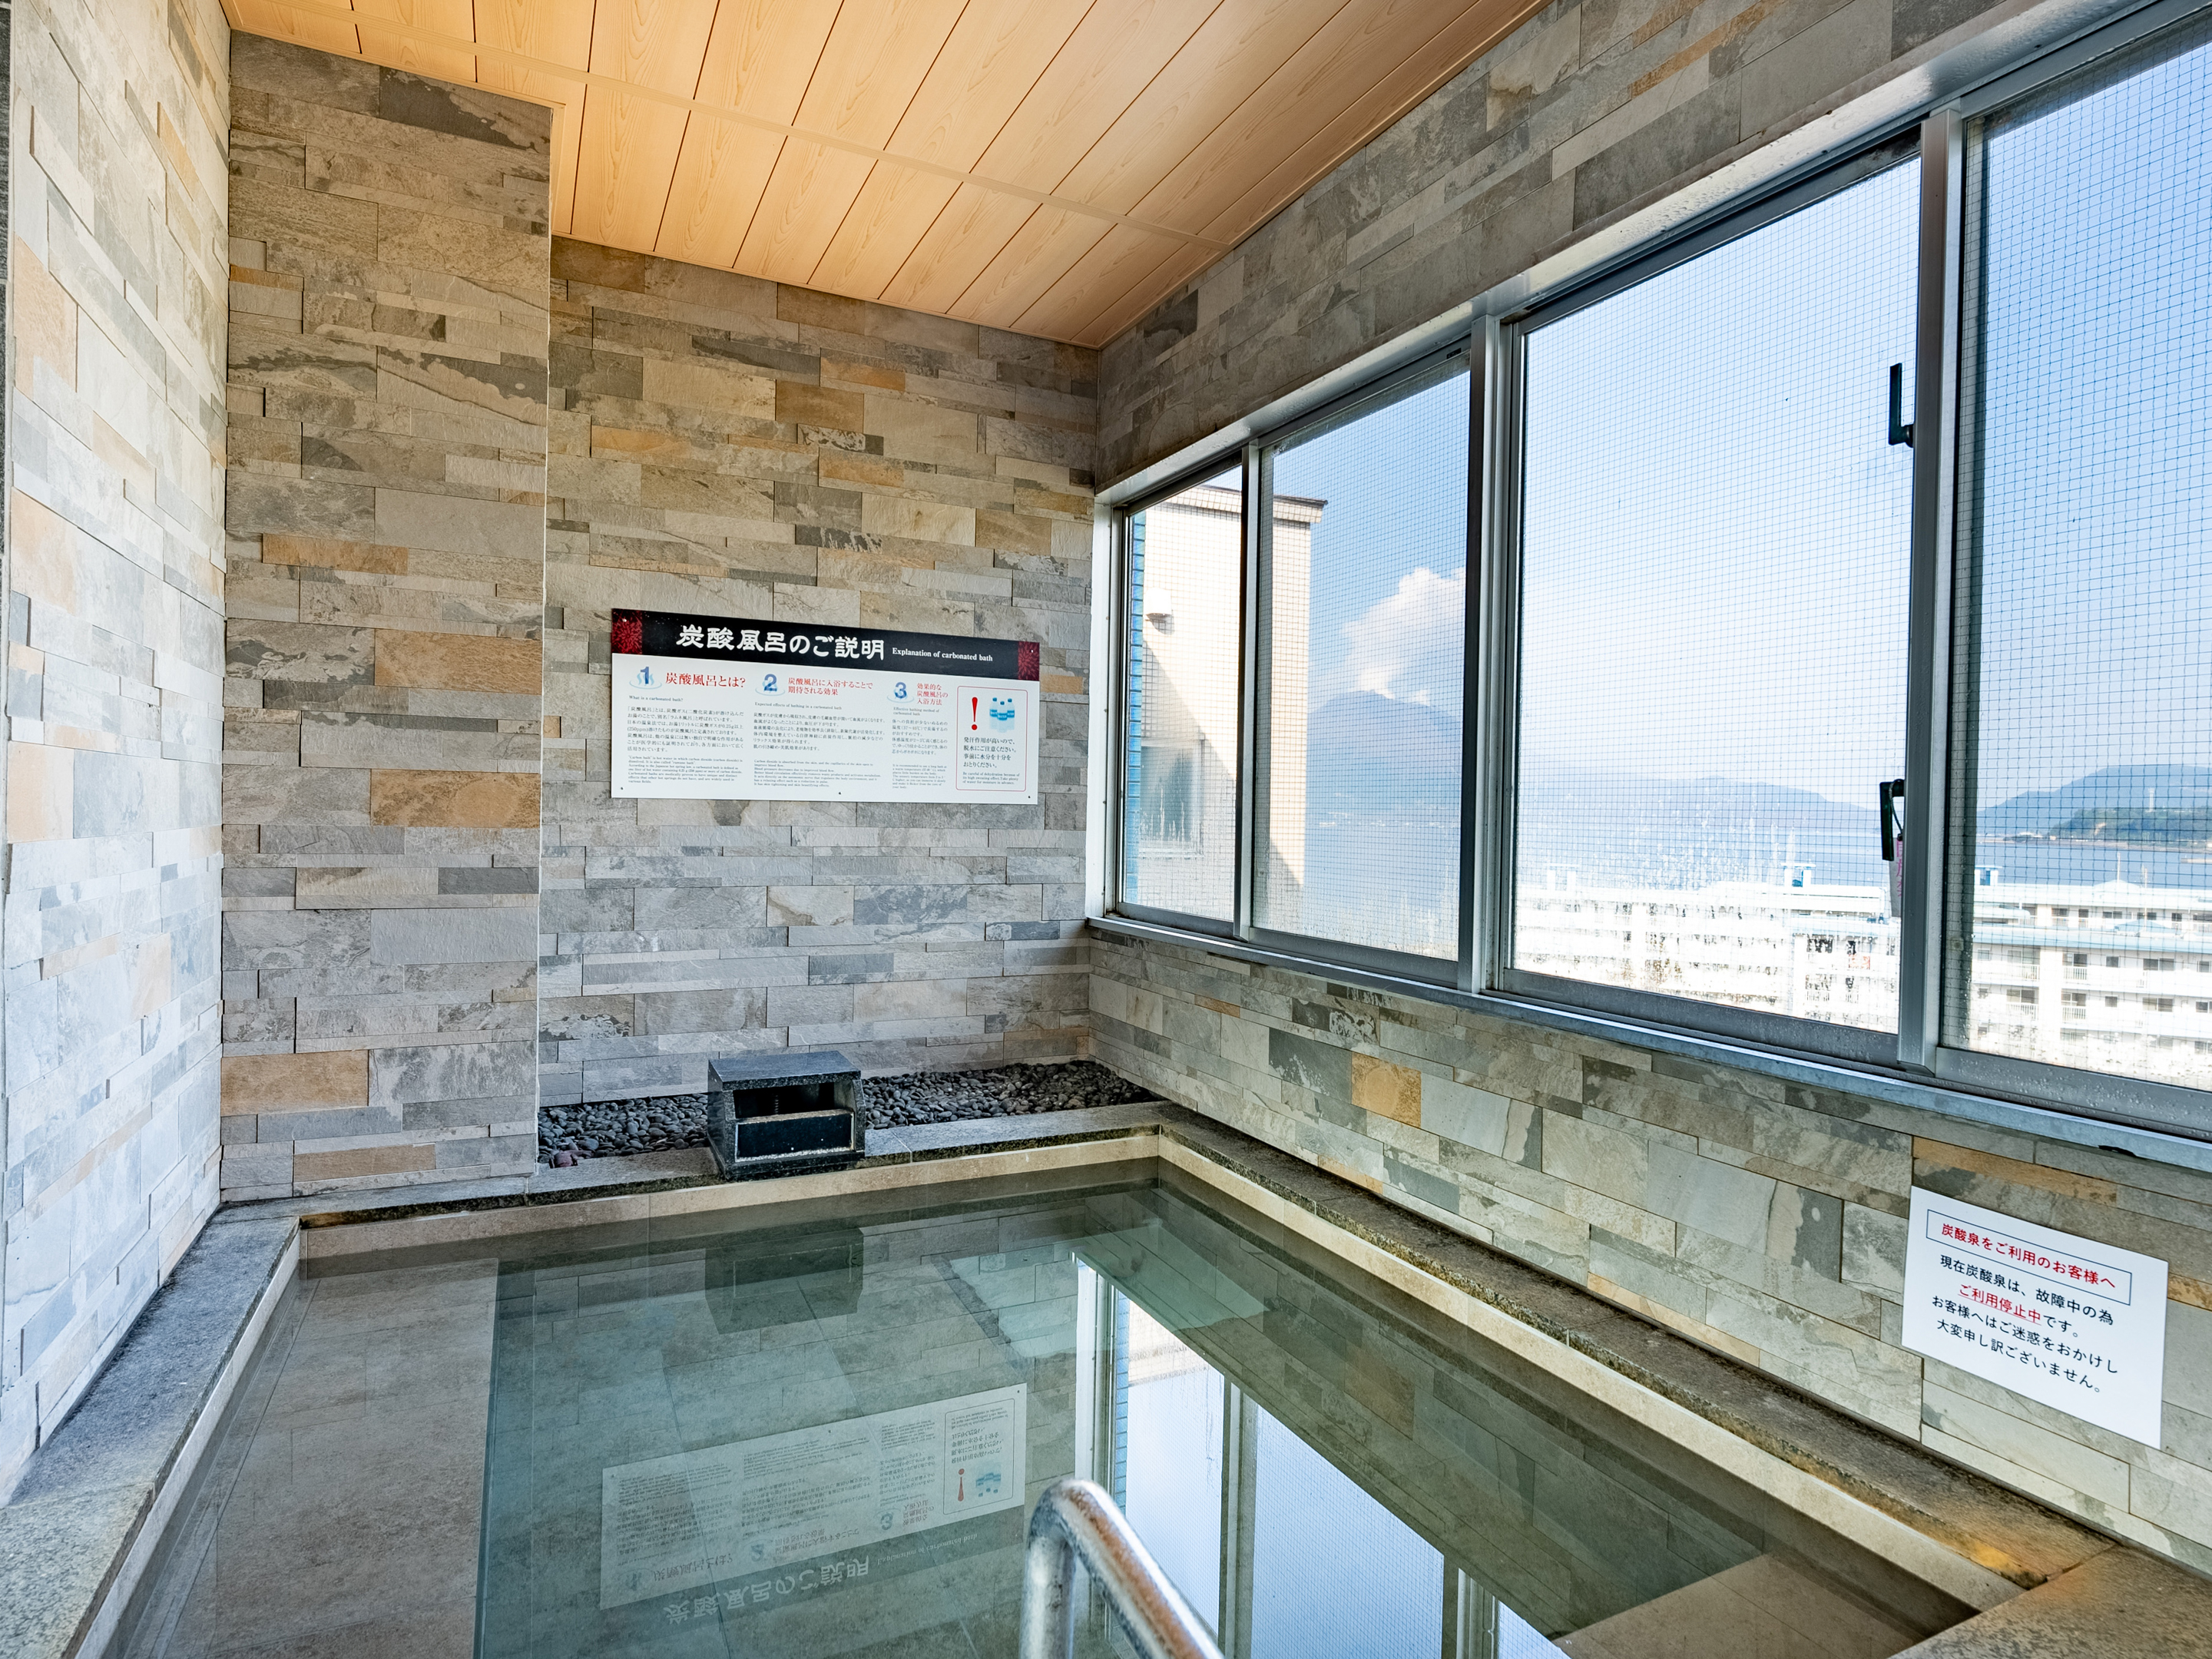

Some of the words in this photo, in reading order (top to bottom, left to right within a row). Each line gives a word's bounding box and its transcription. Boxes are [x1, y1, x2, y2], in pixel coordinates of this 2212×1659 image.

[675, 624, 885, 660] 炭酸風呂のご説明
[892, 647, 931, 657] Explanation
[942, 651, 977, 660] carbonated
[641, 667, 649, 684] 1
[666, 672, 746, 687] 炭酸風呂とは?
[763, 674, 777, 691] 2
[788, 677, 873, 689] 炭酸風呂に入浴することで
[788, 686, 839, 695] 期待される効果
[895, 682, 906, 698] 3
[1942, 1224, 2115, 1288] 炭酸泉をご利用のお客様へ
[1940, 1255, 2114, 1325] 現在炭酸泉は、故障中の為
[1959, 1283, 2078, 1338] ご利用停止中です。
[1932, 1296, 2118, 1373] お客様へはご迷惑をおかけし
[1937, 1319, 2100, 1392] 大変申し訳ございません。
